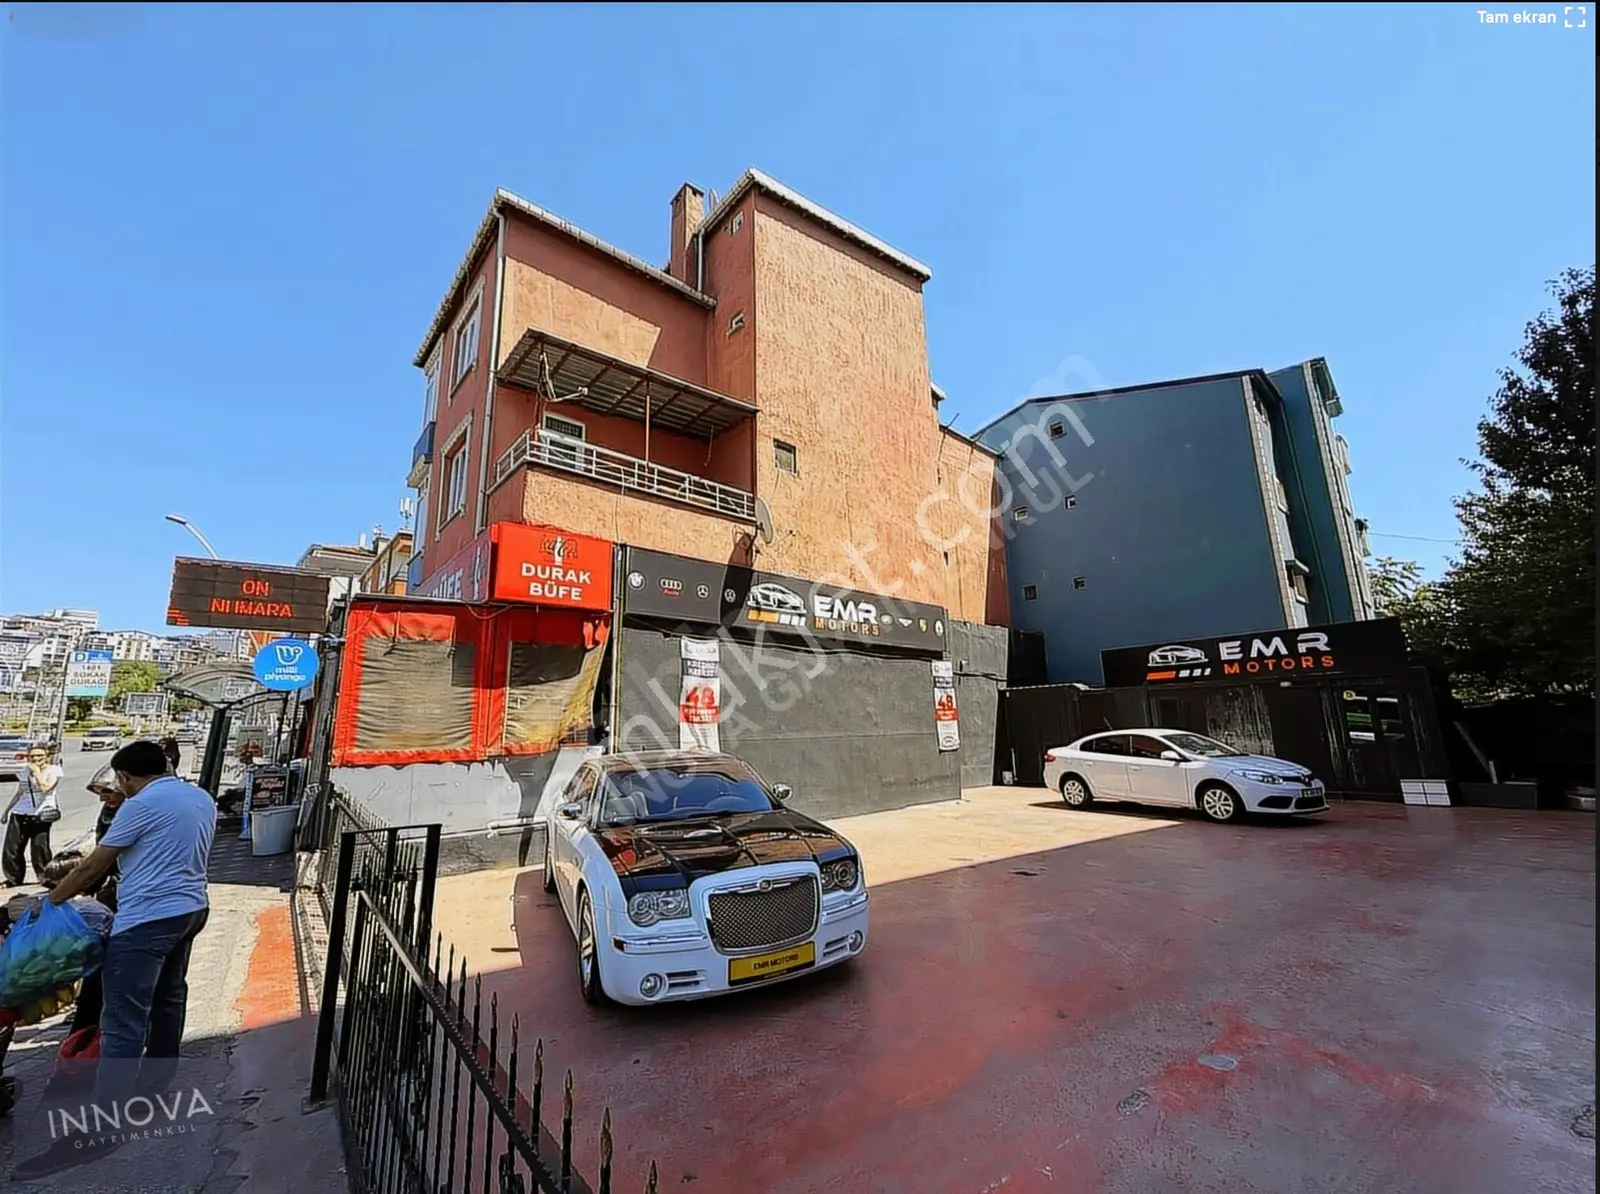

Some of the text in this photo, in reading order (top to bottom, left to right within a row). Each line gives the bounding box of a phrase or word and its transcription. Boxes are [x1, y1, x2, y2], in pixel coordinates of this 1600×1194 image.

[521, 562, 592, 585] DURAK
[242, 579, 270, 596] ON
[529, 580, 583, 601] BÜFE
[814, 595, 879, 625] EMR
[815, 616, 880, 637] MOTORS
[1219, 632, 1332, 661] EMR
[1223, 655, 1335, 675] MOTORS
